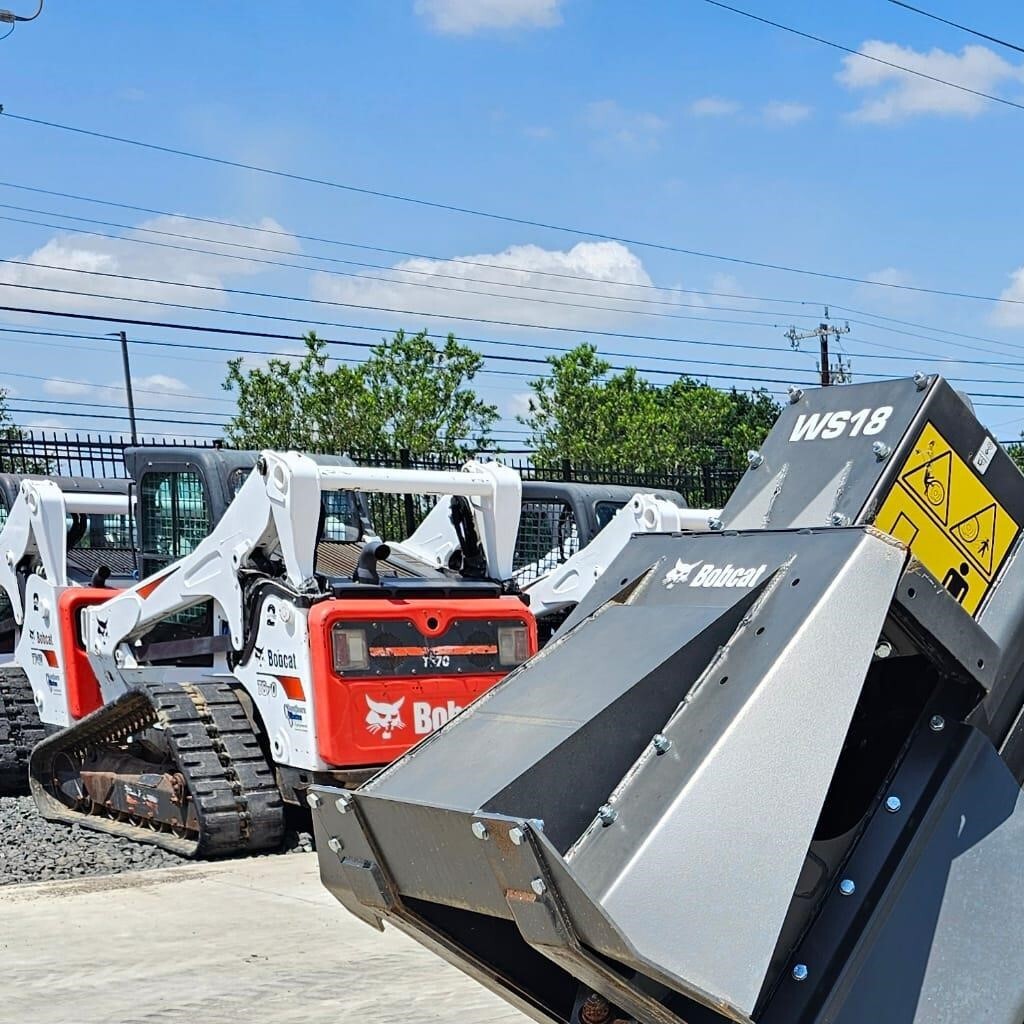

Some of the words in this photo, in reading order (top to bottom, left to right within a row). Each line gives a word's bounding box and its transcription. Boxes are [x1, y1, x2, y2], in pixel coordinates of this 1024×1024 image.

[788, 405, 894, 443] WS18
[688, 563, 768, 588] Bobcat
[267, 649, 297, 670] Bobcat
[413, 700, 465, 735] Bob
